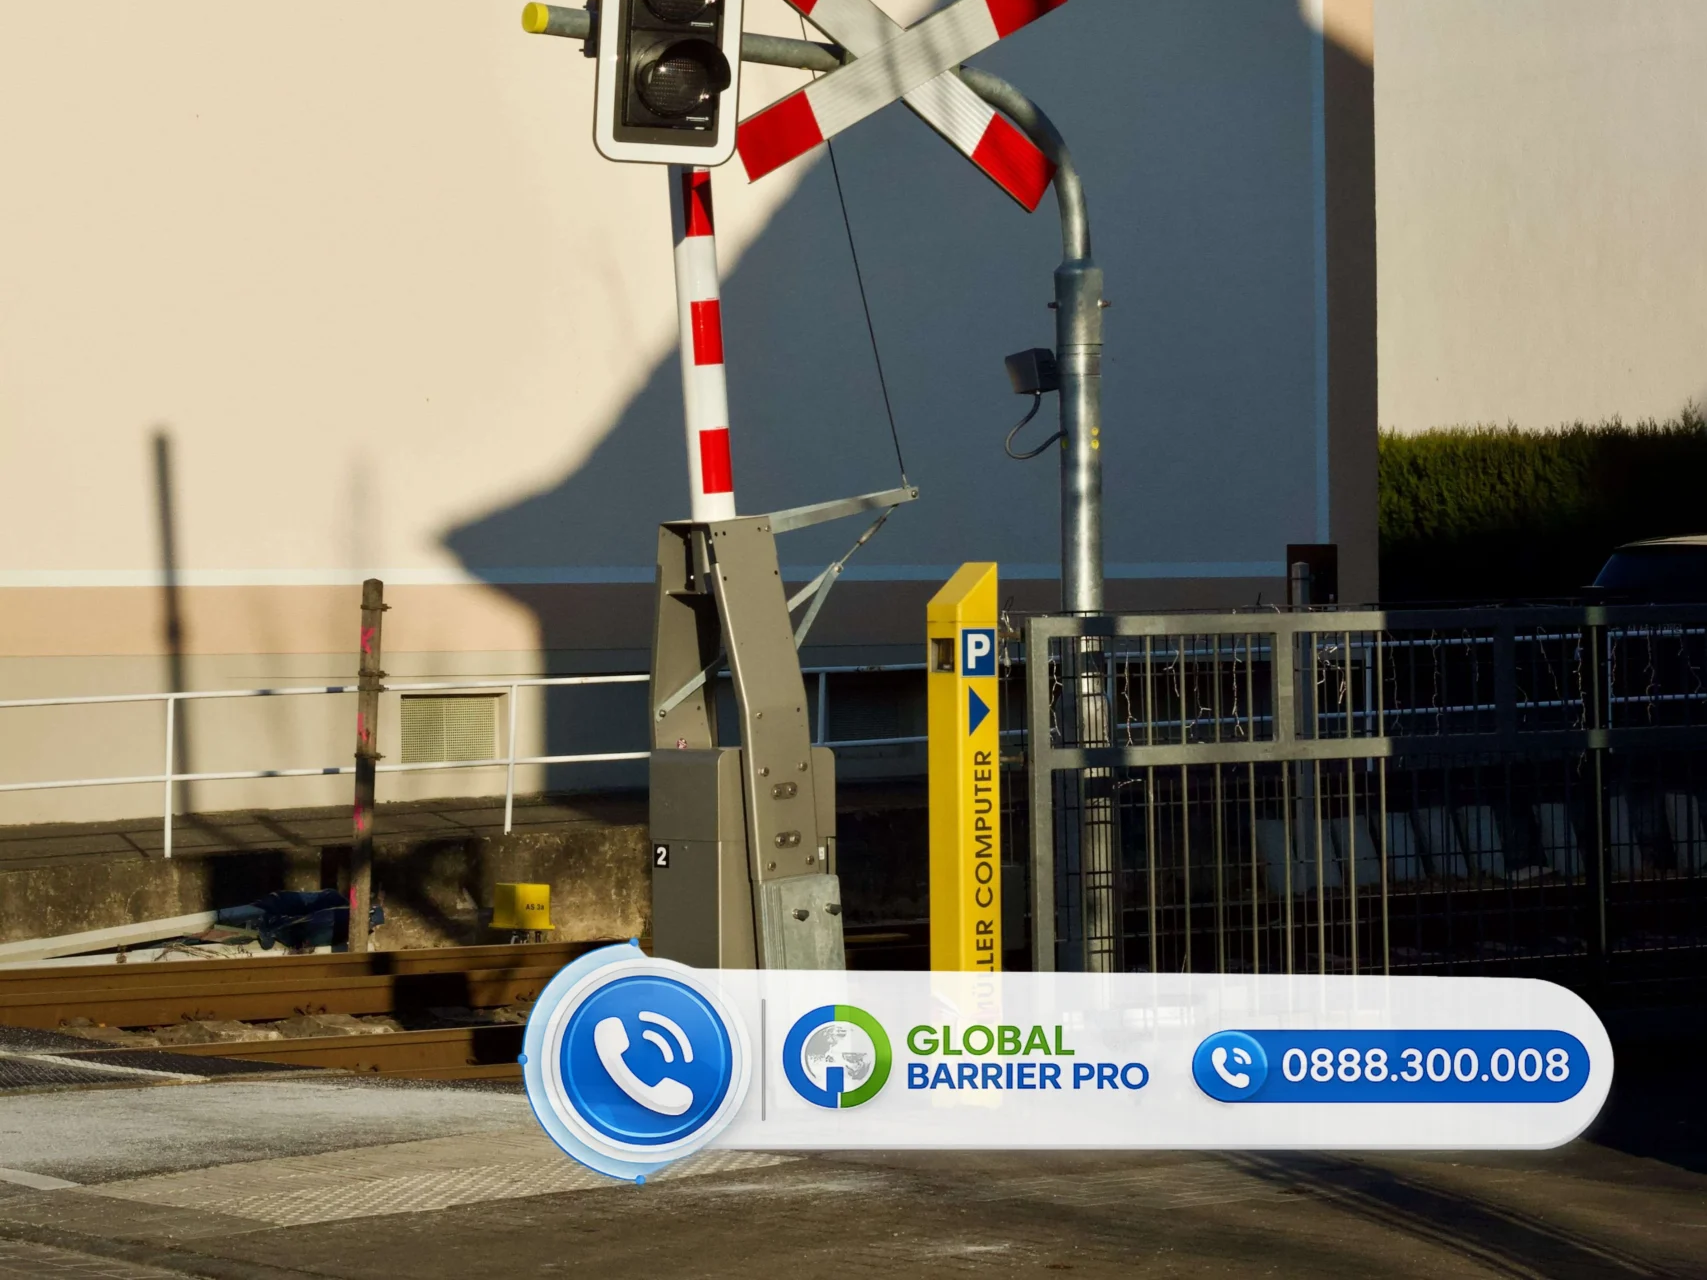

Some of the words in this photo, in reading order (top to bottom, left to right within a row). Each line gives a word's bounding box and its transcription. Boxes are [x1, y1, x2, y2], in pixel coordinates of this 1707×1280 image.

[967, 633, 990, 669] P
[974, 750, 993, 908] COMPUTER
[656, 846, 667, 866] 2
[526, 903, 535, 911] AS
